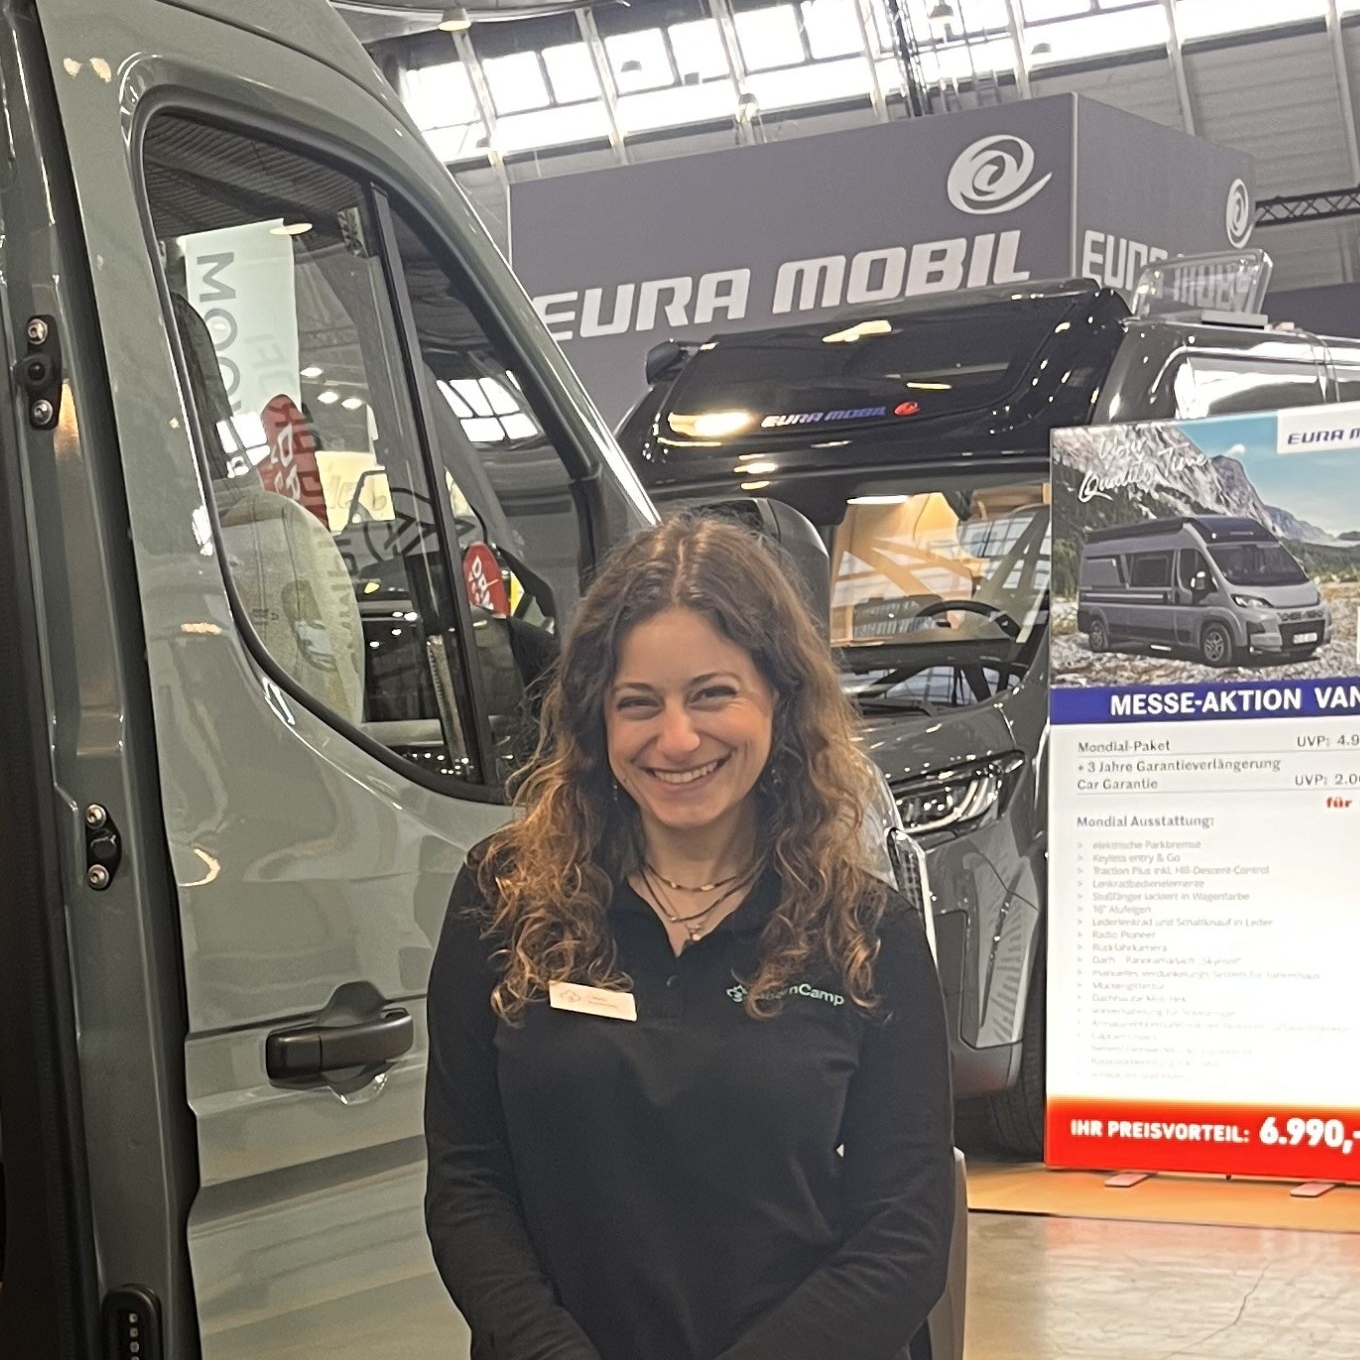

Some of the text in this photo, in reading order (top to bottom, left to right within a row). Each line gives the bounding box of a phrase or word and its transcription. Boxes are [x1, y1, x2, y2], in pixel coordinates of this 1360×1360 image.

[1082, 229, 1169, 290] EUR
[533, 229, 1031, 342] EURA MOBIL
[196, 251, 242, 417] MOO
[761, 411, 824, 428] EURA
[1287, 429, 1345, 445] EURA
[1110, 687, 1302, 716] MESSE-AKTION
[1077, 740, 1171, 753] Mondial-Paket
[1297, 735, 1330, 748] UVP:
[1087, 761, 1096, 773] 3
[1098, 760, 1133, 773] Jahre
[1136, 758, 1282, 773] Garantieverlängerung
[1077, 773, 1360, 790] Car Garantie UVP: 2.0
[1326, 796, 1353, 808] für
[1076, 815, 1214, 829] Mondial Ausstattung:
[1071, 1119, 1103, 1137] IHR
[1107, 1120, 1250, 1143] PREISVORTEIL:
